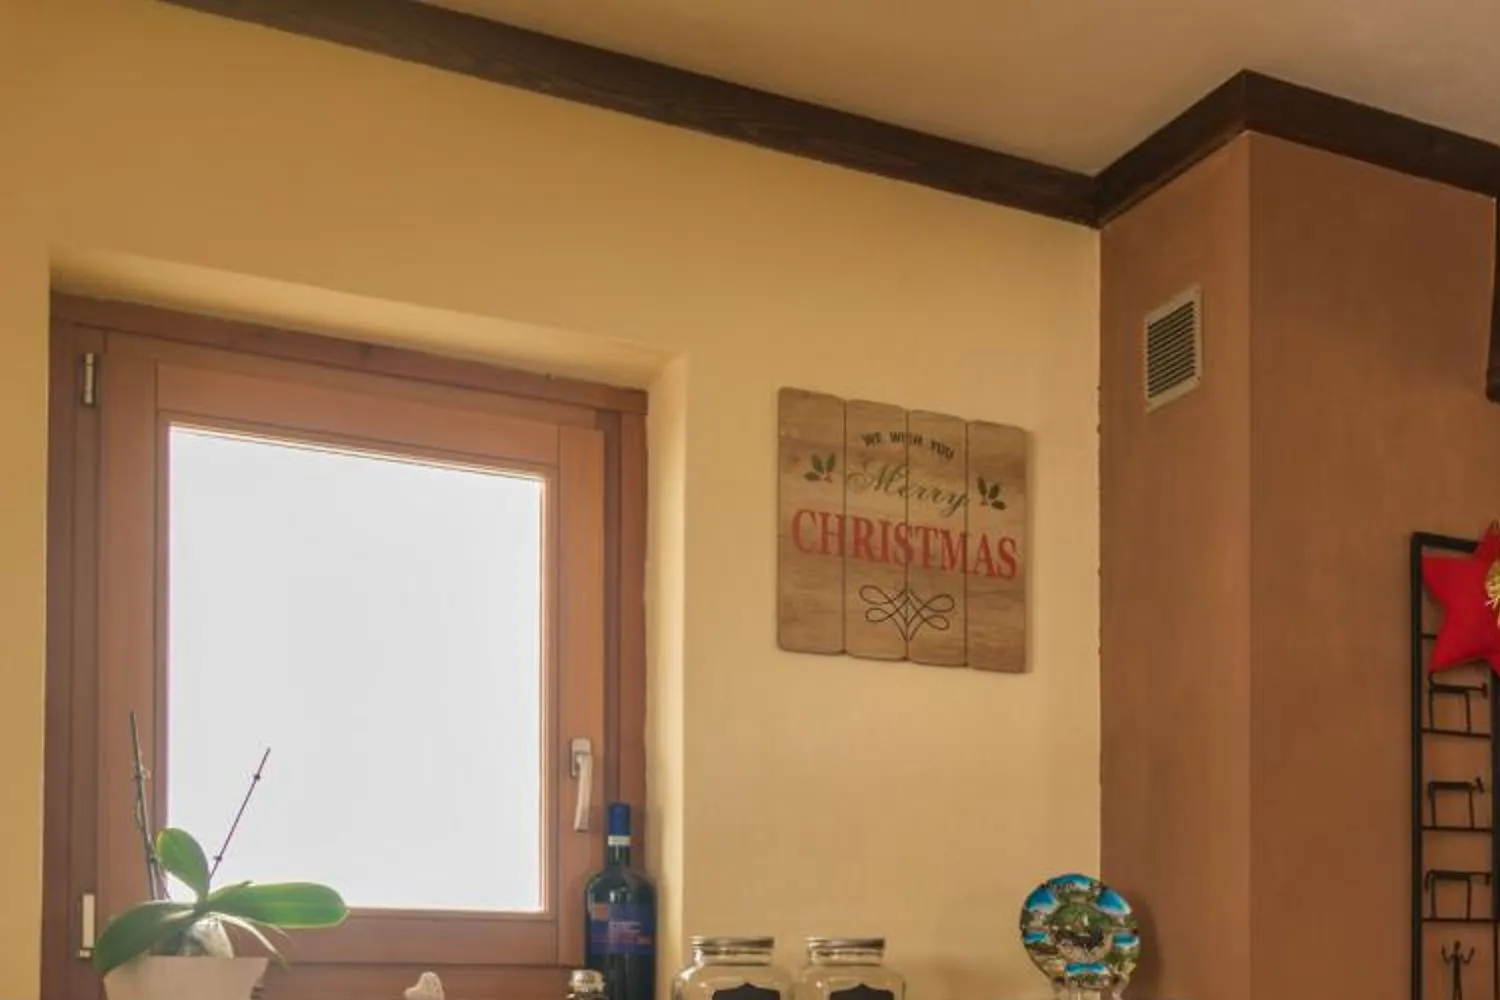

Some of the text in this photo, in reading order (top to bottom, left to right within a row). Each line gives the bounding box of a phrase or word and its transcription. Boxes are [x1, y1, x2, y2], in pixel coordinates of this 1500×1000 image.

[861, 431, 954, 460] WE WISH YOU
[848, 460, 968, 516] Merry
[792, 508, 1018, 579] CHRISTMAS
